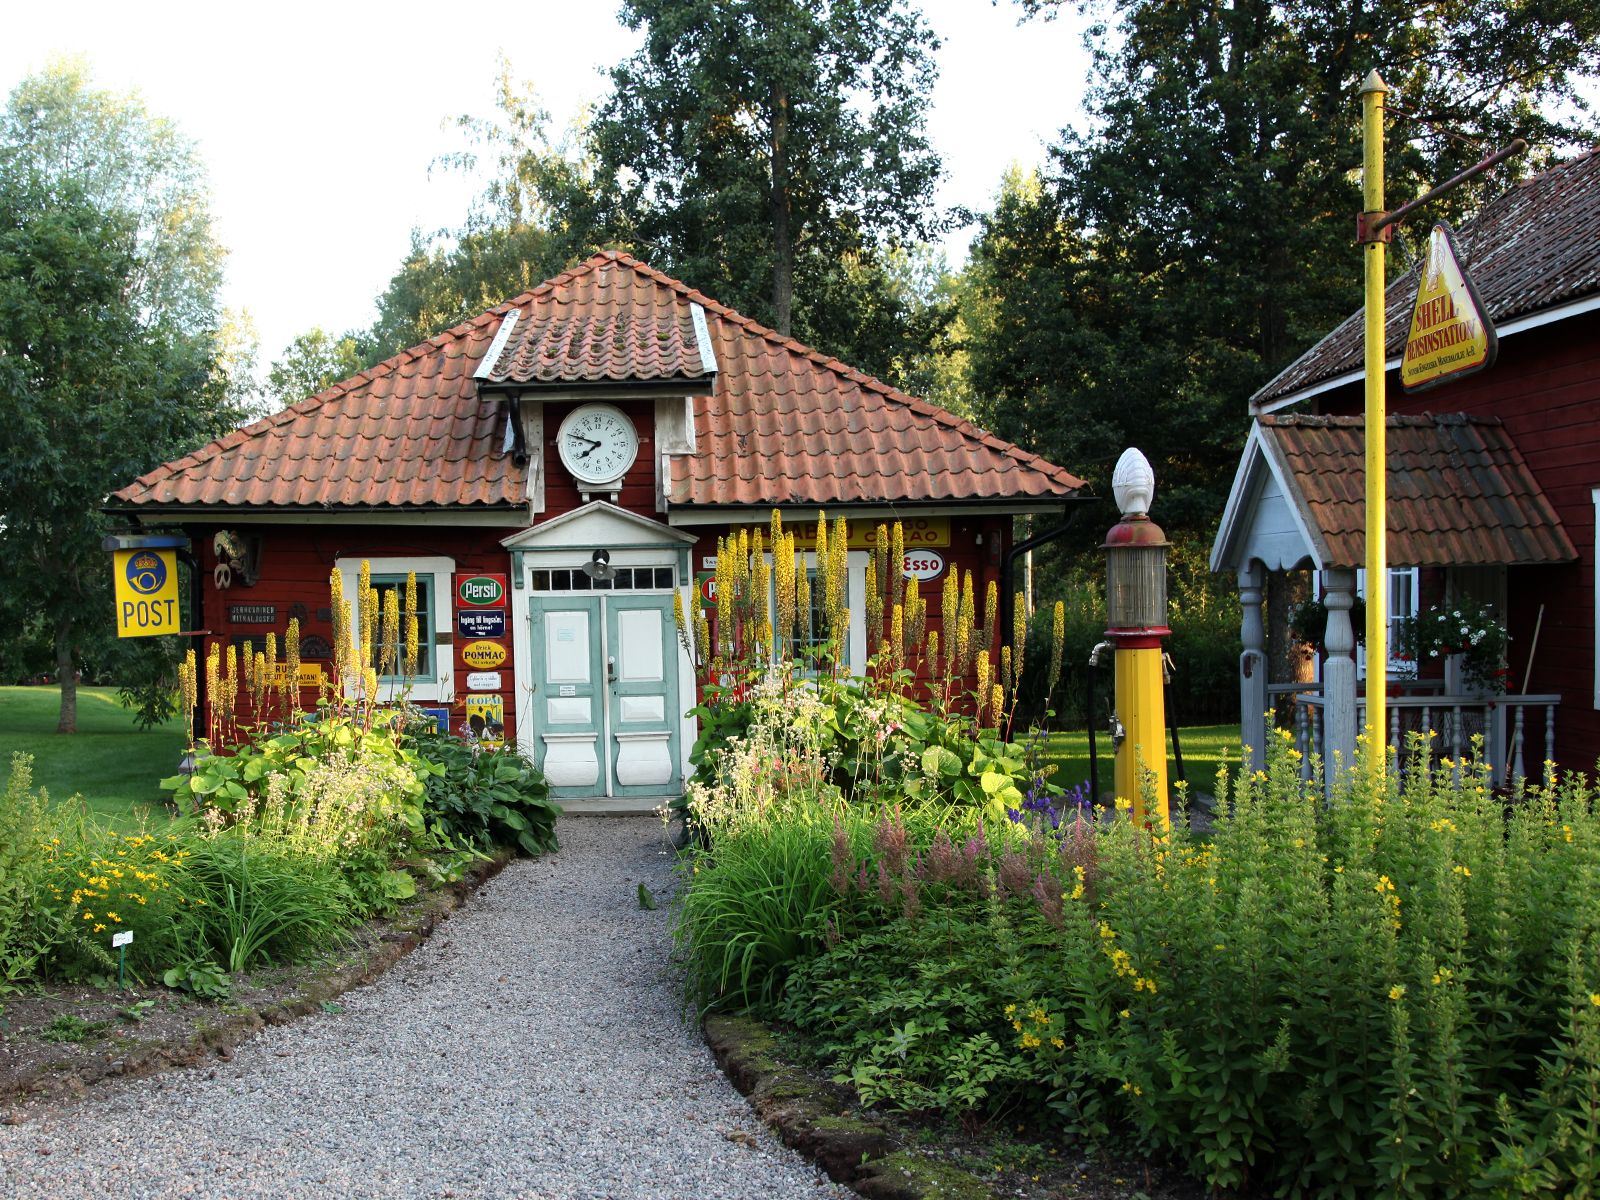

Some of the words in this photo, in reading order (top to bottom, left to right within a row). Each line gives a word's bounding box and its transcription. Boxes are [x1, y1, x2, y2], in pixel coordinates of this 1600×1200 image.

[1416, 293, 1459, 332] SHELL
[1407, 318, 1475, 361] BENSINSTATION
[465, 582, 497, 598] Persil
[123, 600, 175, 628] POST
[464, 651, 504, 659] POMMAC
[467, 697, 501, 705] ICOPAL
